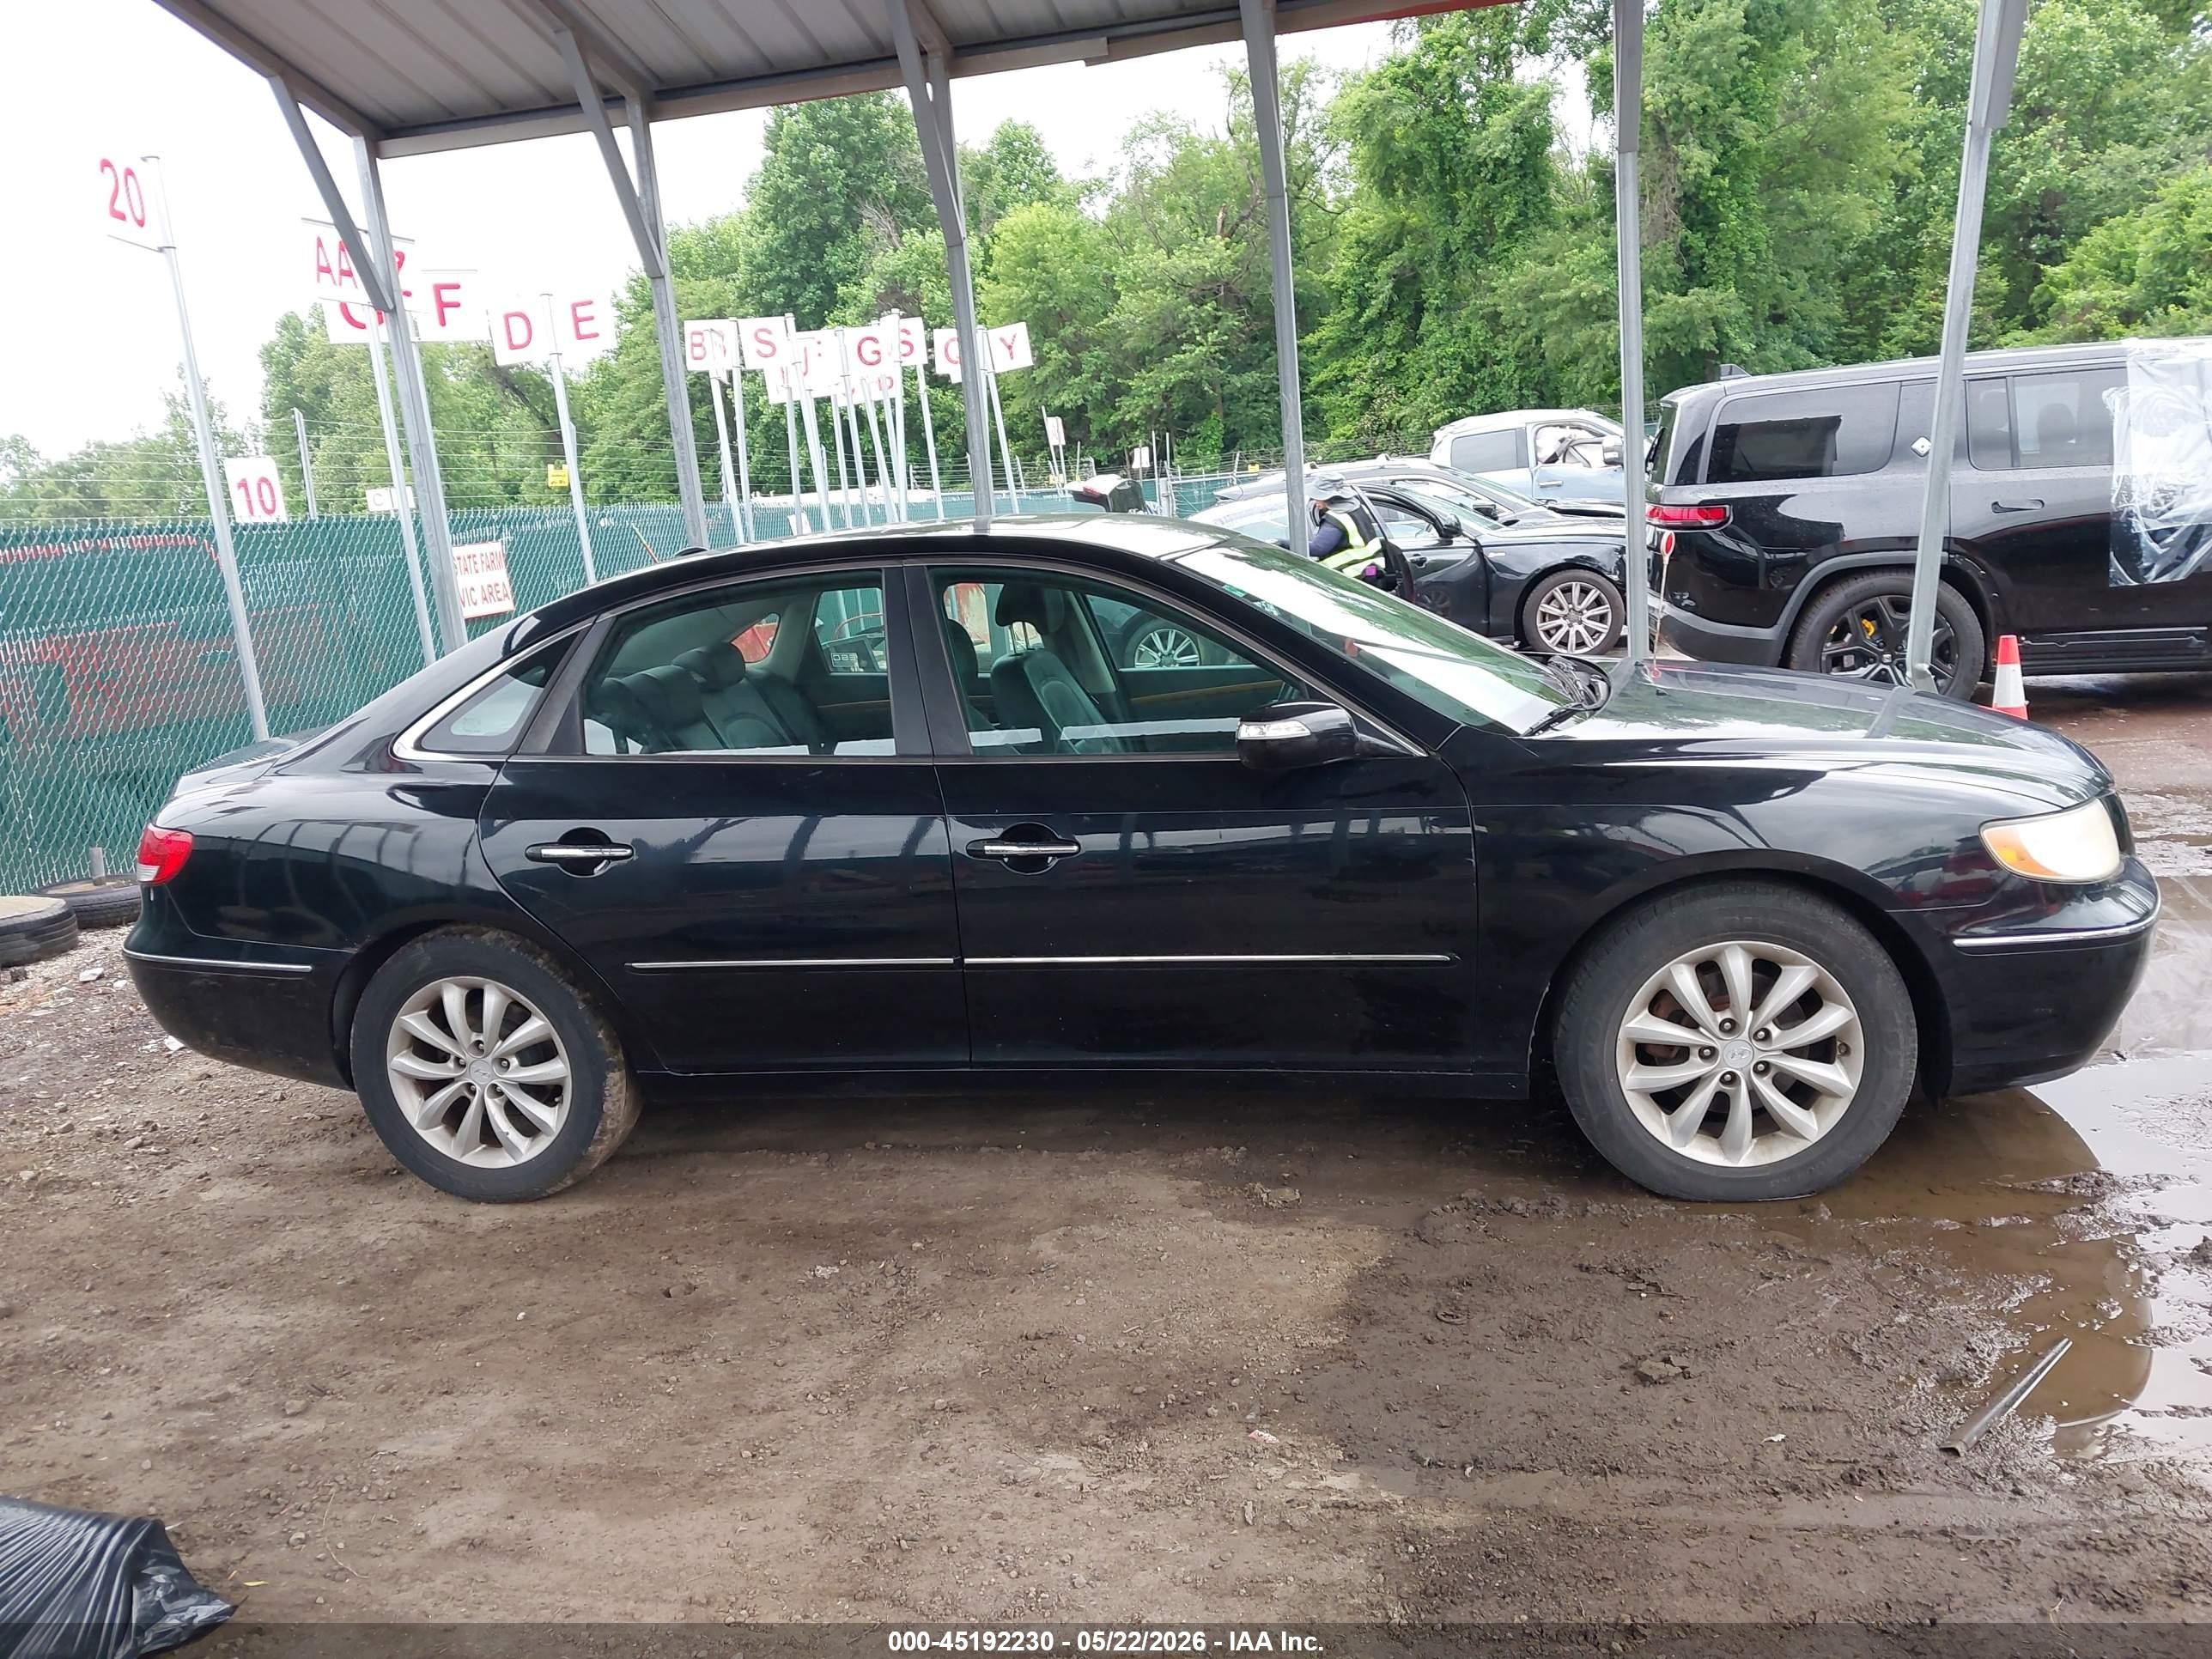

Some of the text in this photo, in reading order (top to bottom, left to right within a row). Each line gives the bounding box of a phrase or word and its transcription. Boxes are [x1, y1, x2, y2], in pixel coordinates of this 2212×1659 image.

[99, 158, 146, 228] 20
[316, 235, 358, 289] AA
[431, 283, 462, 328] F
[570, 300, 600, 341] E
[503, 311, 532, 350] D
[690, 331, 707, 361] B
[753, 328, 777, 358] S
[999, 333, 1018, 361] Y
[857, 336, 882, 367] G
[236, 476, 276, 516] 10
[480, 550, 504, 574] FARM
[481, 581, 510, 605] AREA
